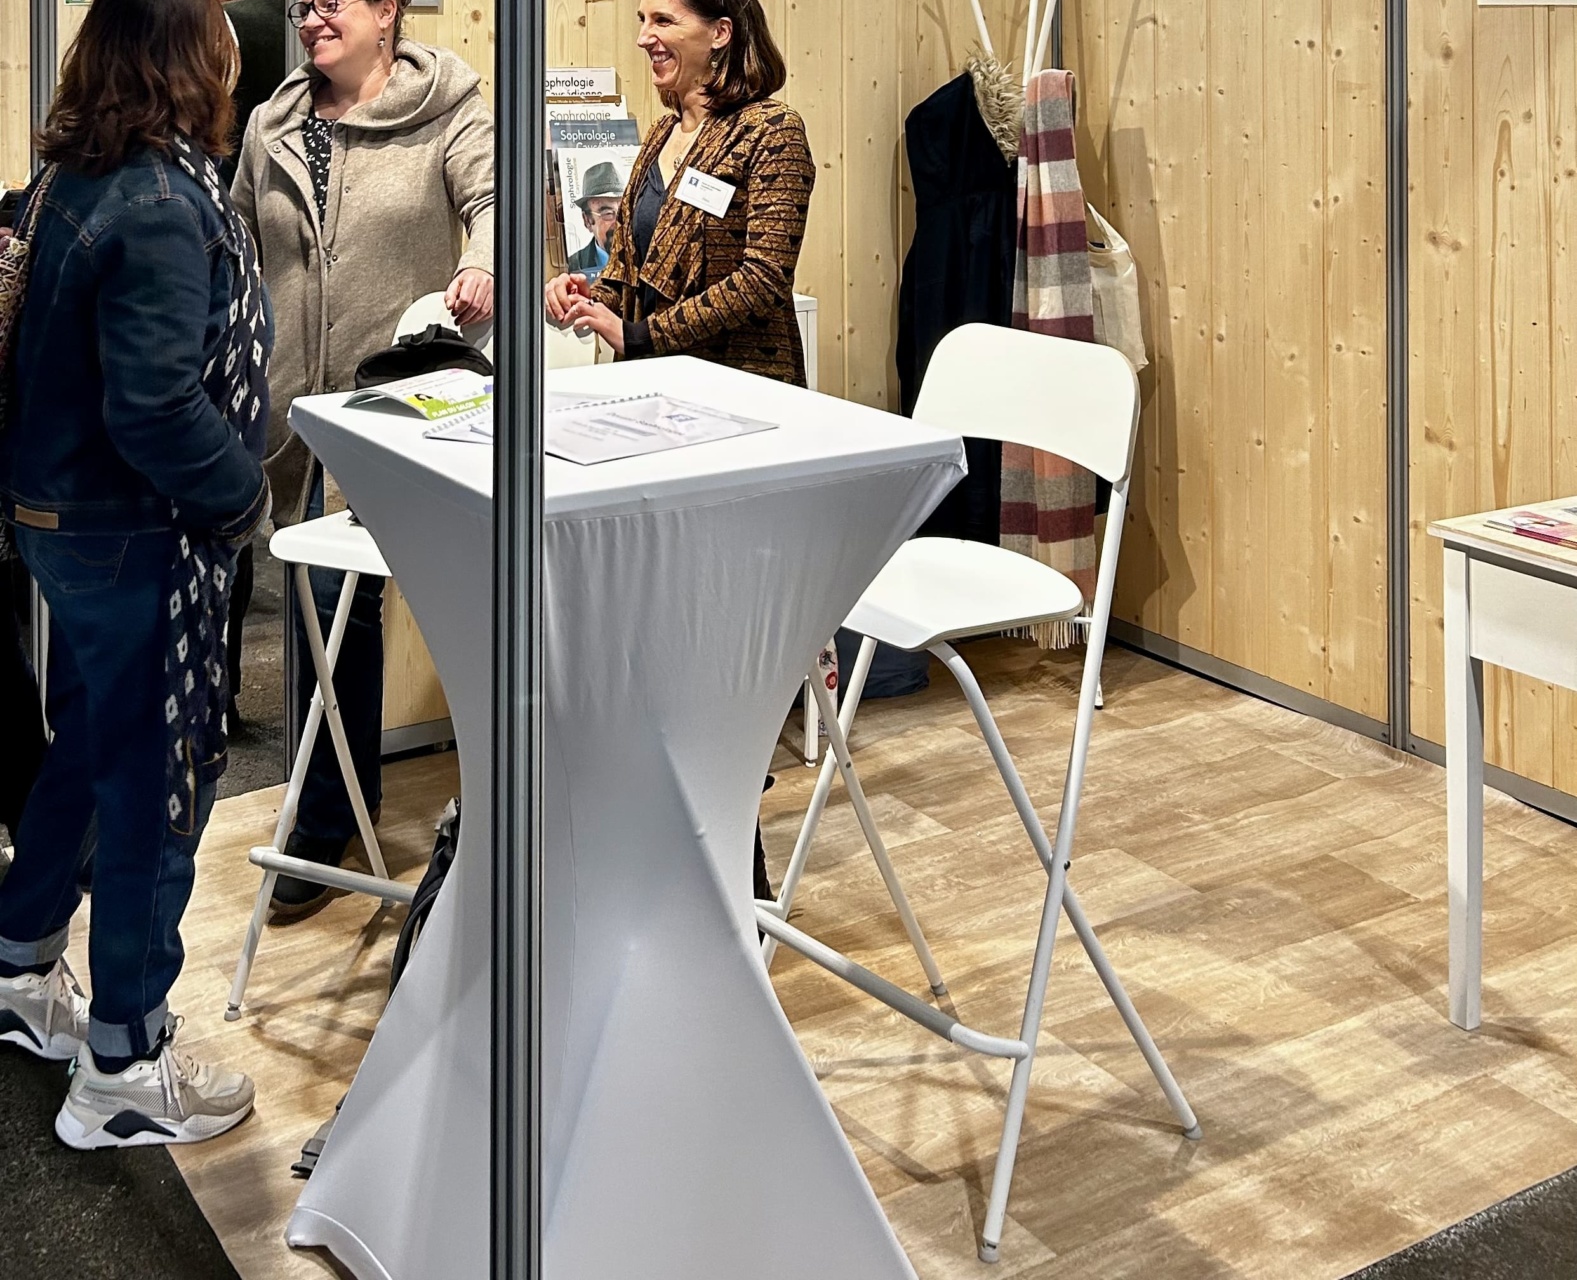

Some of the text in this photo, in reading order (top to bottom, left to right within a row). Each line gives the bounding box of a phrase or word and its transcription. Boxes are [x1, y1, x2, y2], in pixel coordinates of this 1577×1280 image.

[545, 76, 595, 90] ophrologie
[549, 109, 611, 121] Sophrologie
[560, 129, 616, 143] Sophrologie
[565, 157, 577, 209] Sophrologie
